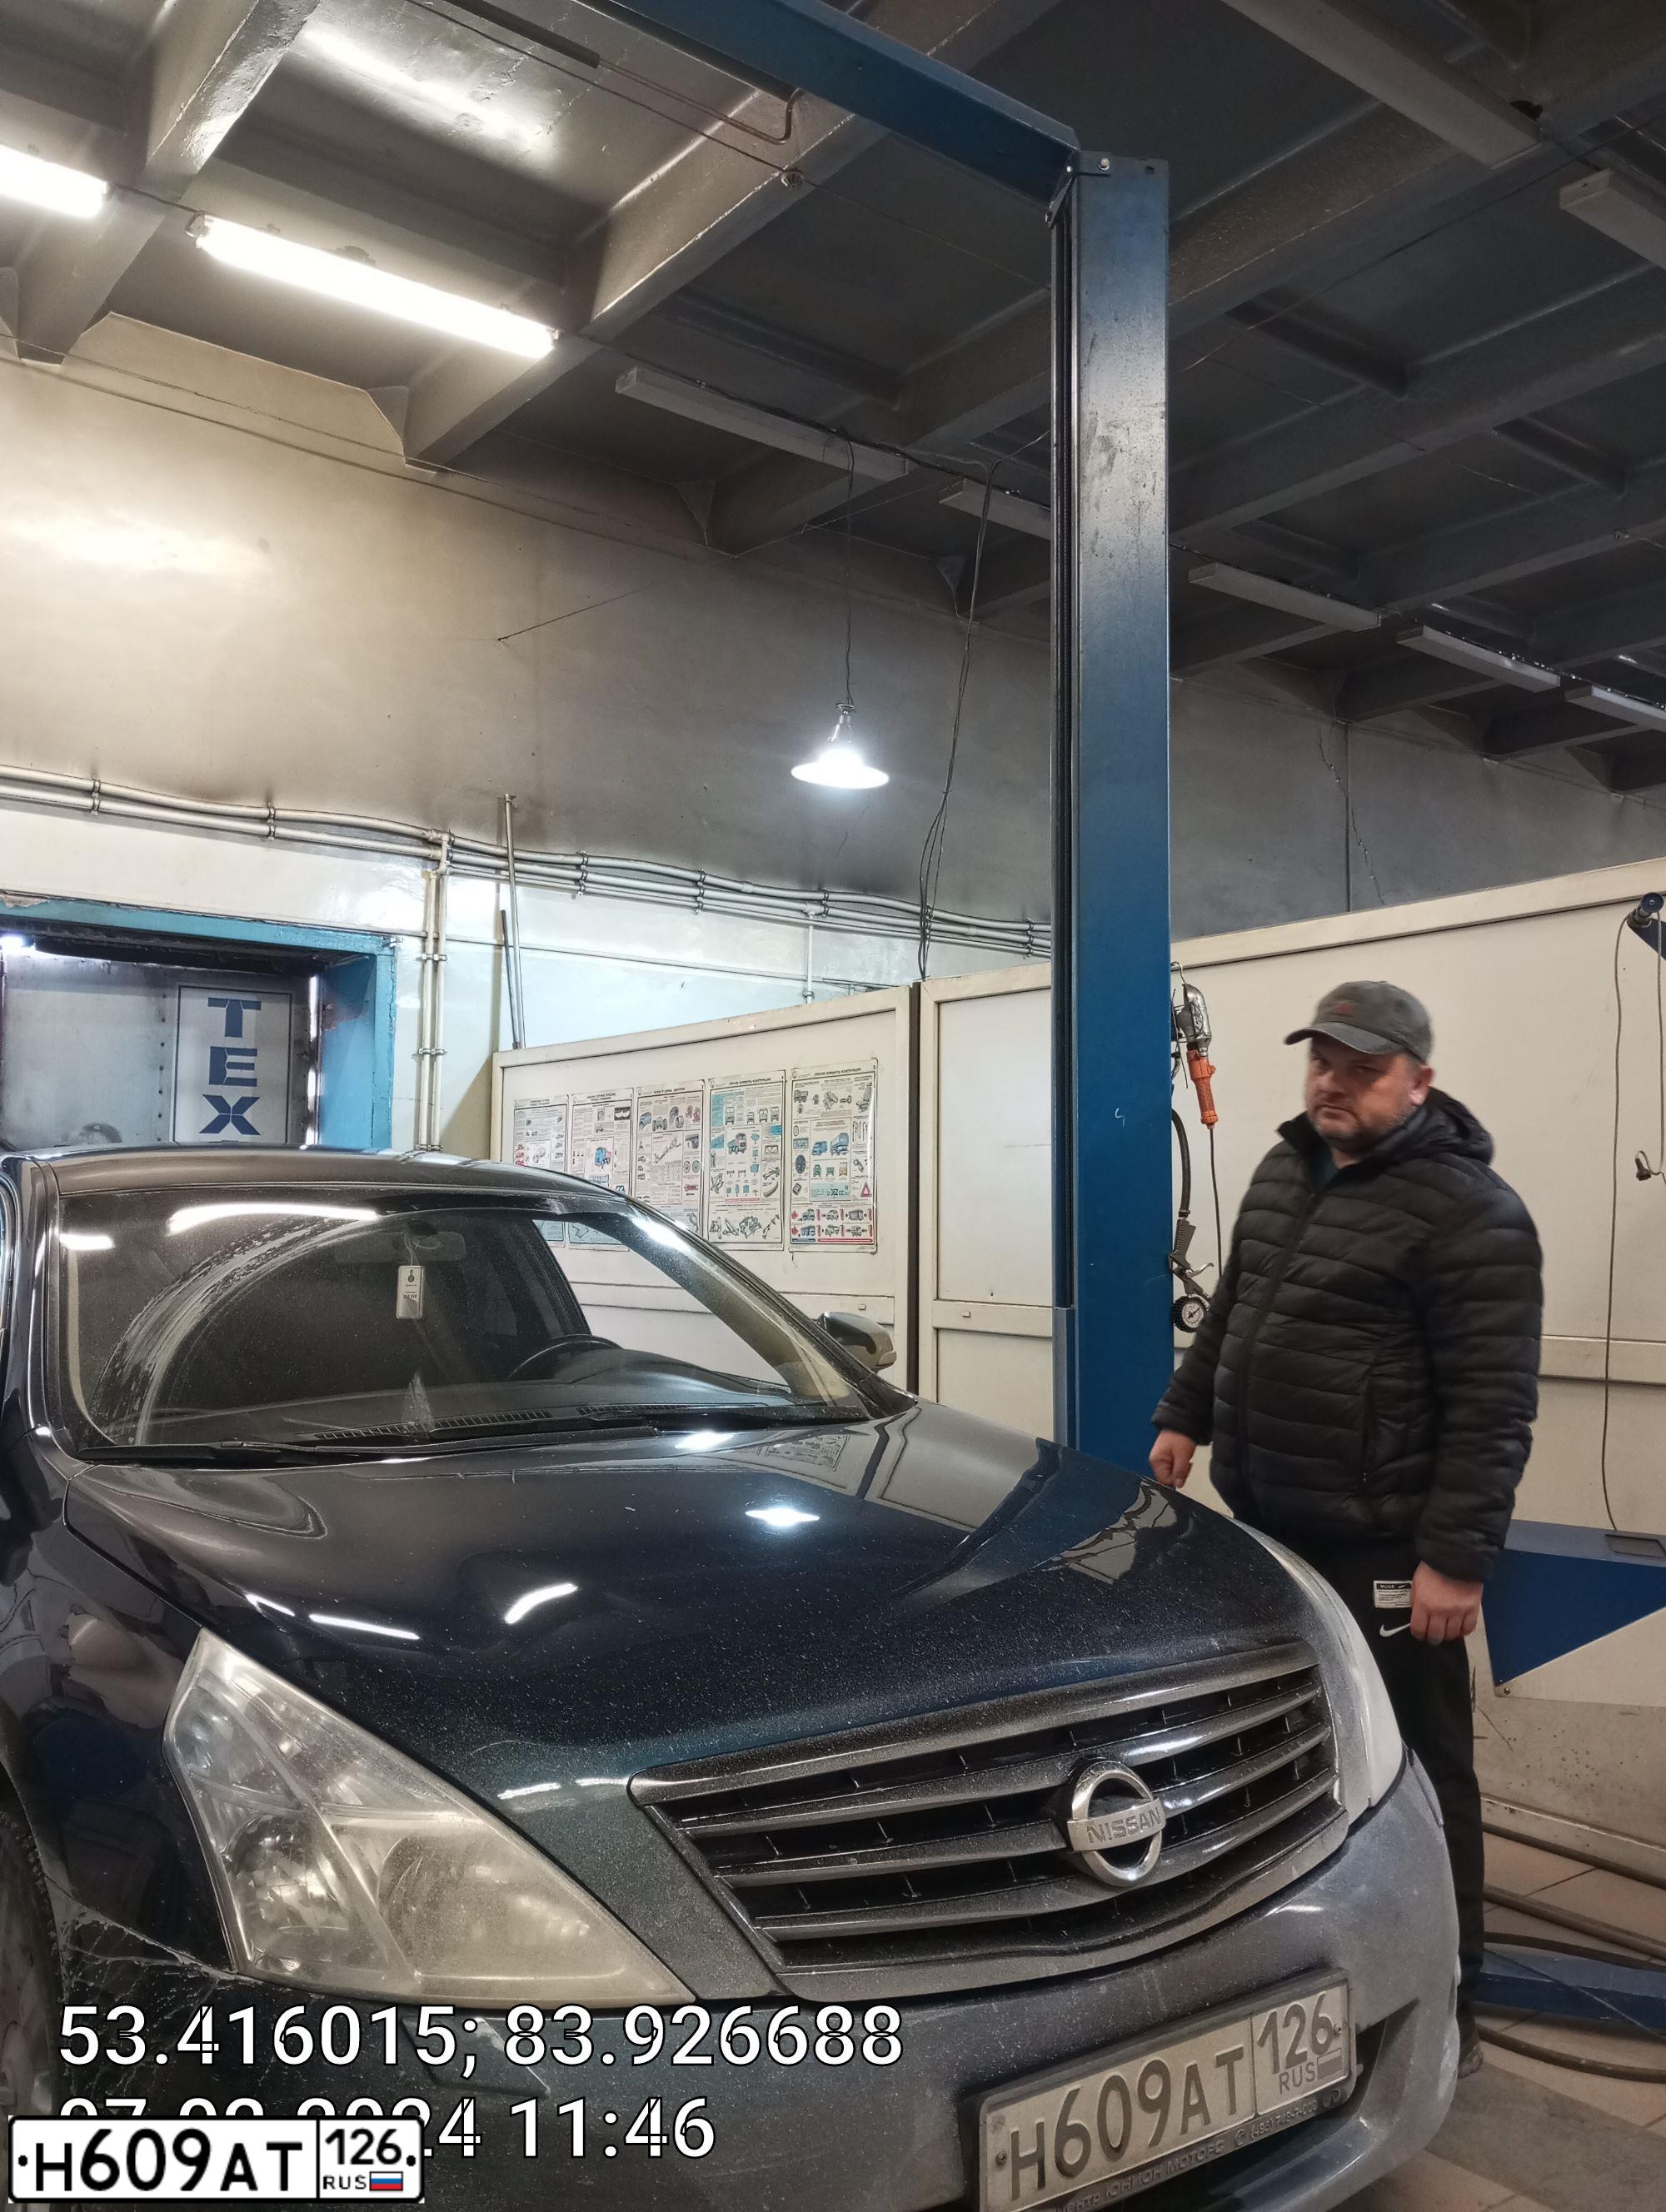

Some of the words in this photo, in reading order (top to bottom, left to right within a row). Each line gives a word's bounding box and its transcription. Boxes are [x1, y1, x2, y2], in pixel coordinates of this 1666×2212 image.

[1086, 1806, 1162, 1844] NISSAN
[1255, 1991, 1334, 2075] 126
[1279, 2065, 1317, 2094] RUS
